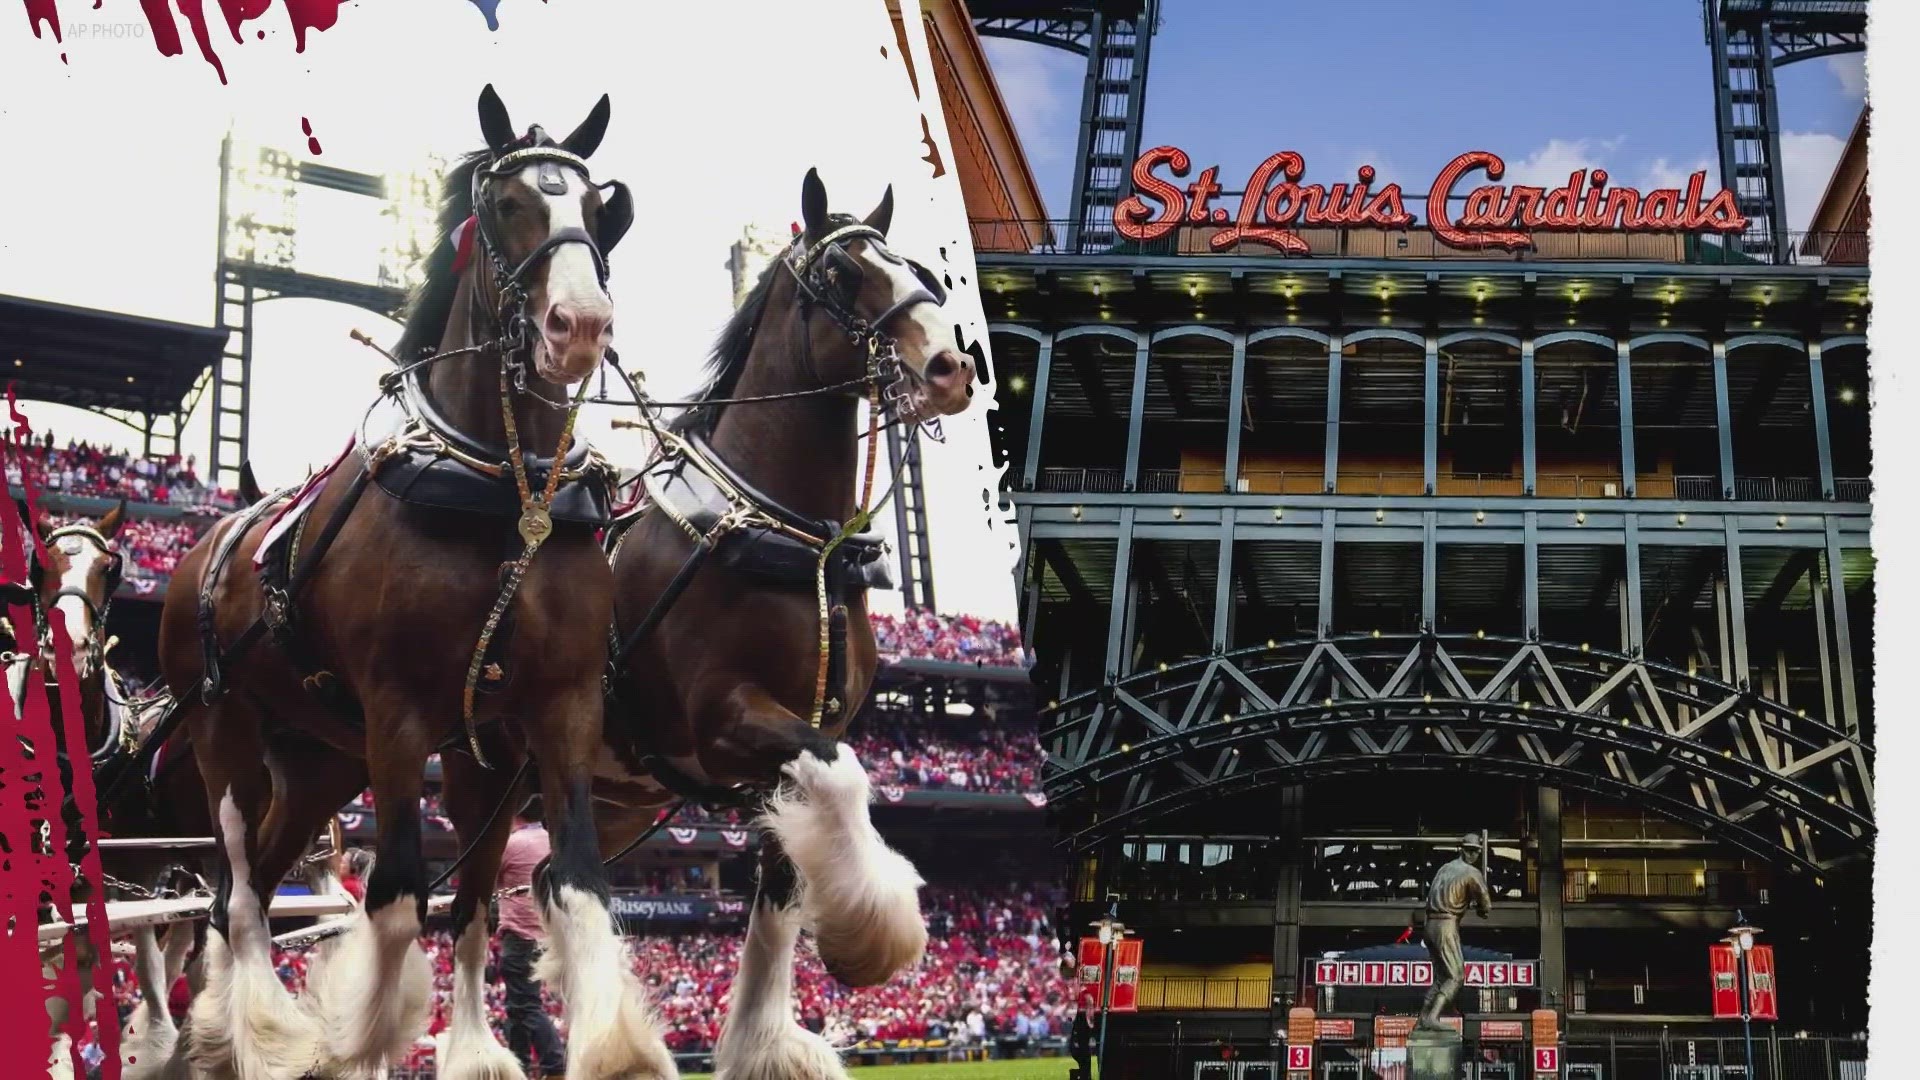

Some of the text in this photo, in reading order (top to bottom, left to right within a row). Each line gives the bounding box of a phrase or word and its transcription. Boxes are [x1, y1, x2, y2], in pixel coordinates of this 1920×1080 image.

[1209, 149, 1415, 255] Louis
[1424, 150, 1750, 252] Cardinals
[1320, 962, 1532, 985] THIRD ASE
[1295, 1048, 1304, 1066] 3
[1541, 1050, 1551, 1068] 3
